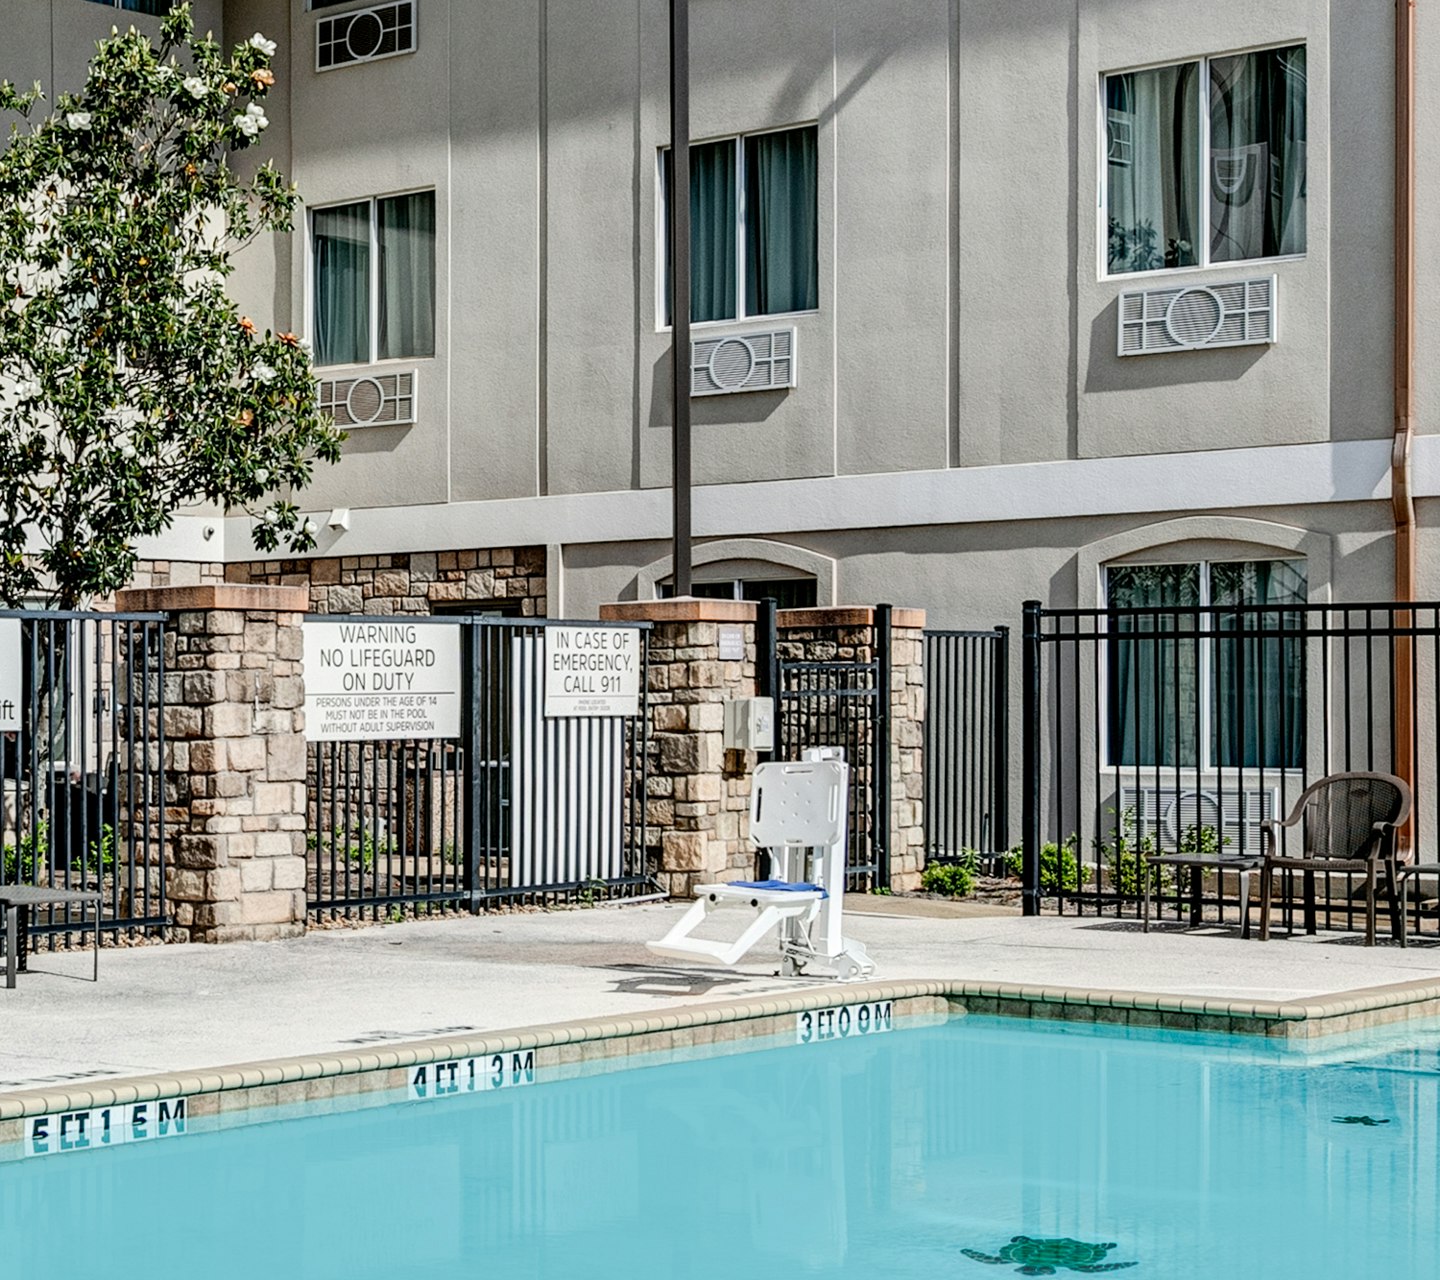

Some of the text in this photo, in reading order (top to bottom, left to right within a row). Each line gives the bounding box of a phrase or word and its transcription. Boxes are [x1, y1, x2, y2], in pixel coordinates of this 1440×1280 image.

[339, 625, 416, 644] WARNING
[556, 631, 630, 650] IN CASE OF
[320, 648, 436, 668] NO LIFEGUARD
[553, 653, 633, 673] EMERGENCY,
[342, 672, 415, 691] ON DUTY
[563, 675, 621, 693] CALL 911
[316, 696, 438, 708] PERSONS UNDER THE AGE OF 14
[325, 708, 428, 720] MUST NOT BE IN THE POOL
[320, 721, 436, 733] WITHOUT ADULT SUPERVISION
